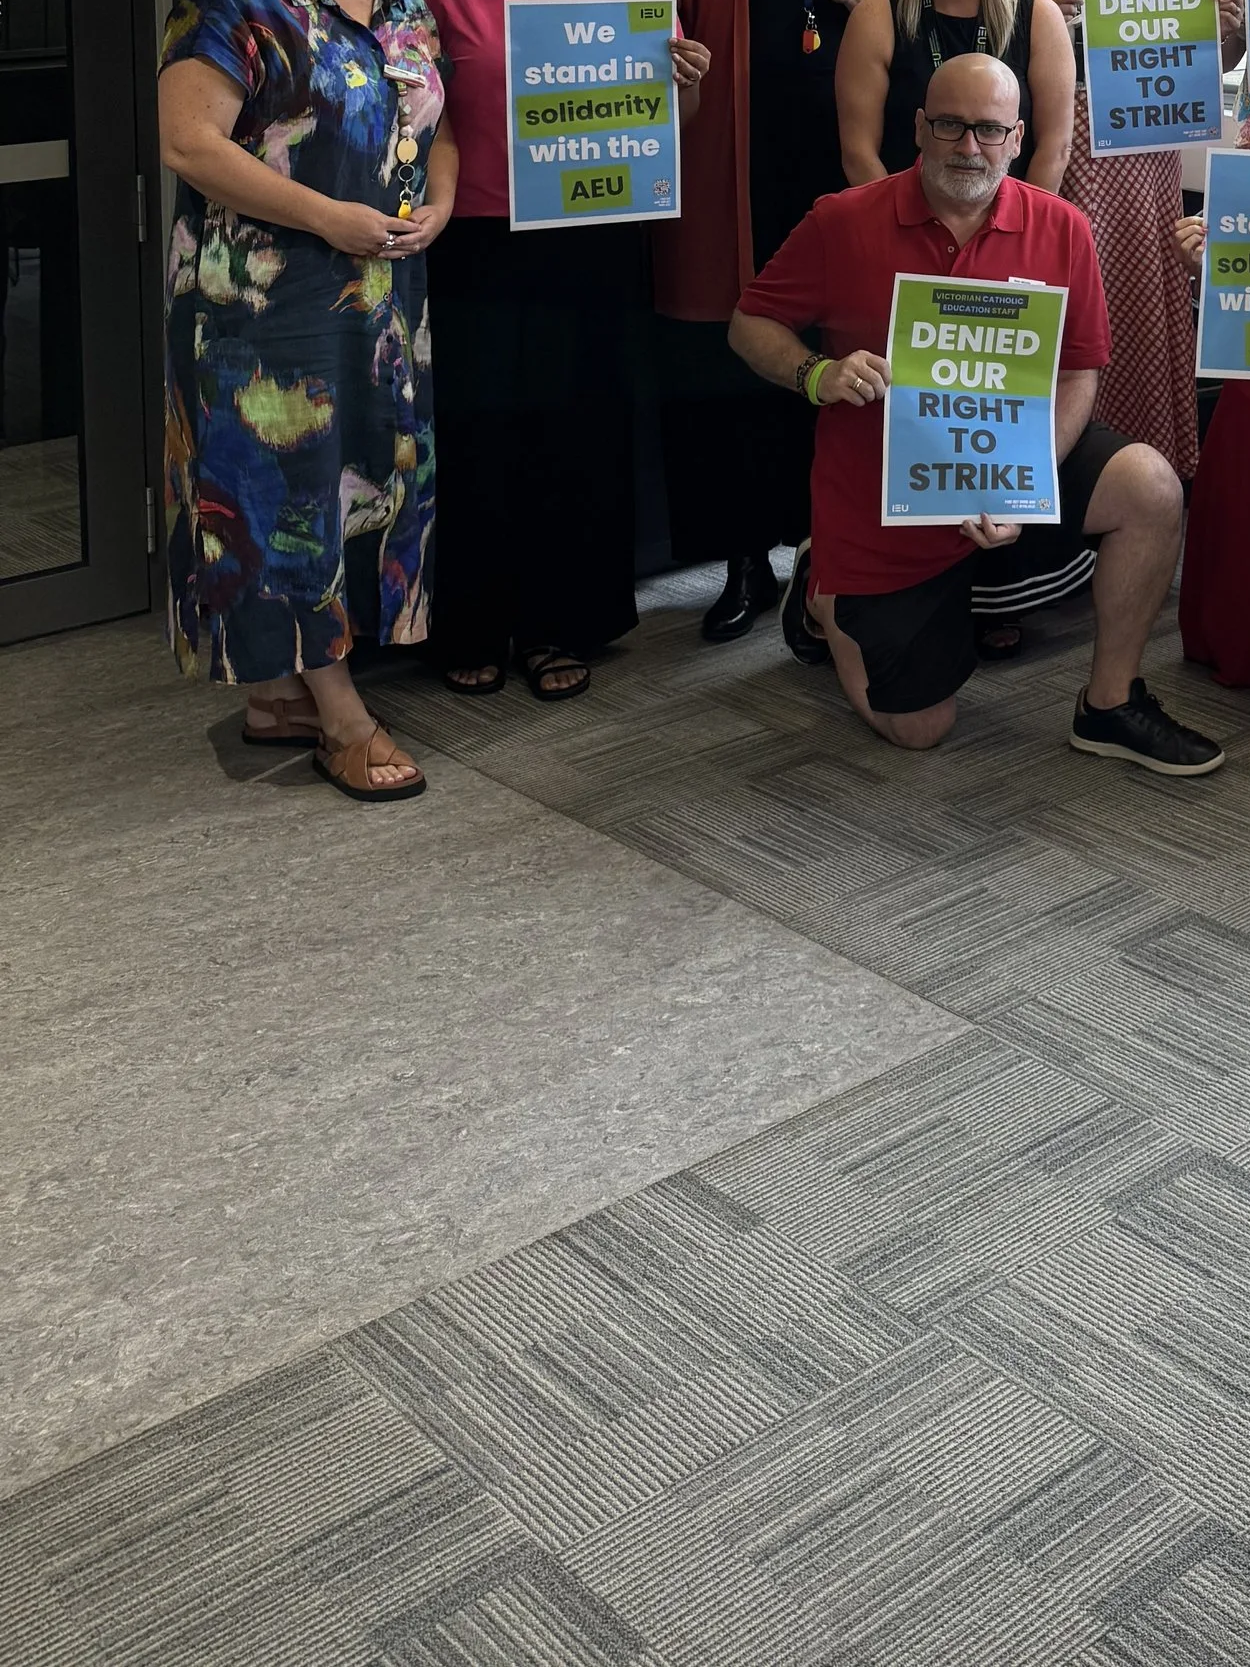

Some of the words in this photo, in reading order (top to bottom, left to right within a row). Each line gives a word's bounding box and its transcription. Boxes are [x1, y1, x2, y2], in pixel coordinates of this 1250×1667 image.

[641, 9, 664, 19] IEU
[564, 22, 615, 45] We
[1119, 18, 1179, 42] OUR
[525, 59, 618, 84] stand
[625, 55, 653, 80] in
[1111, 45, 1196, 71] RIGHT
[1136, 76, 1175, 98] TO
[526, 94, 661, 126] solidarity
[1109, 102, 1205, 129] STRIKE
[529, 136, 600, 162] with
[608, 135, 660, 158] the
[571, 176, 624, 201] AEU
[936, 293, 981, 302] VICTORIAN
[982, 295, 1024, 305] CATHOLIC
[943, 304, 990, 313] EDUCATION
[992, 308, 1016, 316] STAFF
[911, 321, 1040, 356] DENIED
[932, 359, 1007, 389] OUR
[919, 392, 1024, 423] RIGHT
[948, 428, 996, 453] TO
[910, 463, 1034, 491] STRIKE
